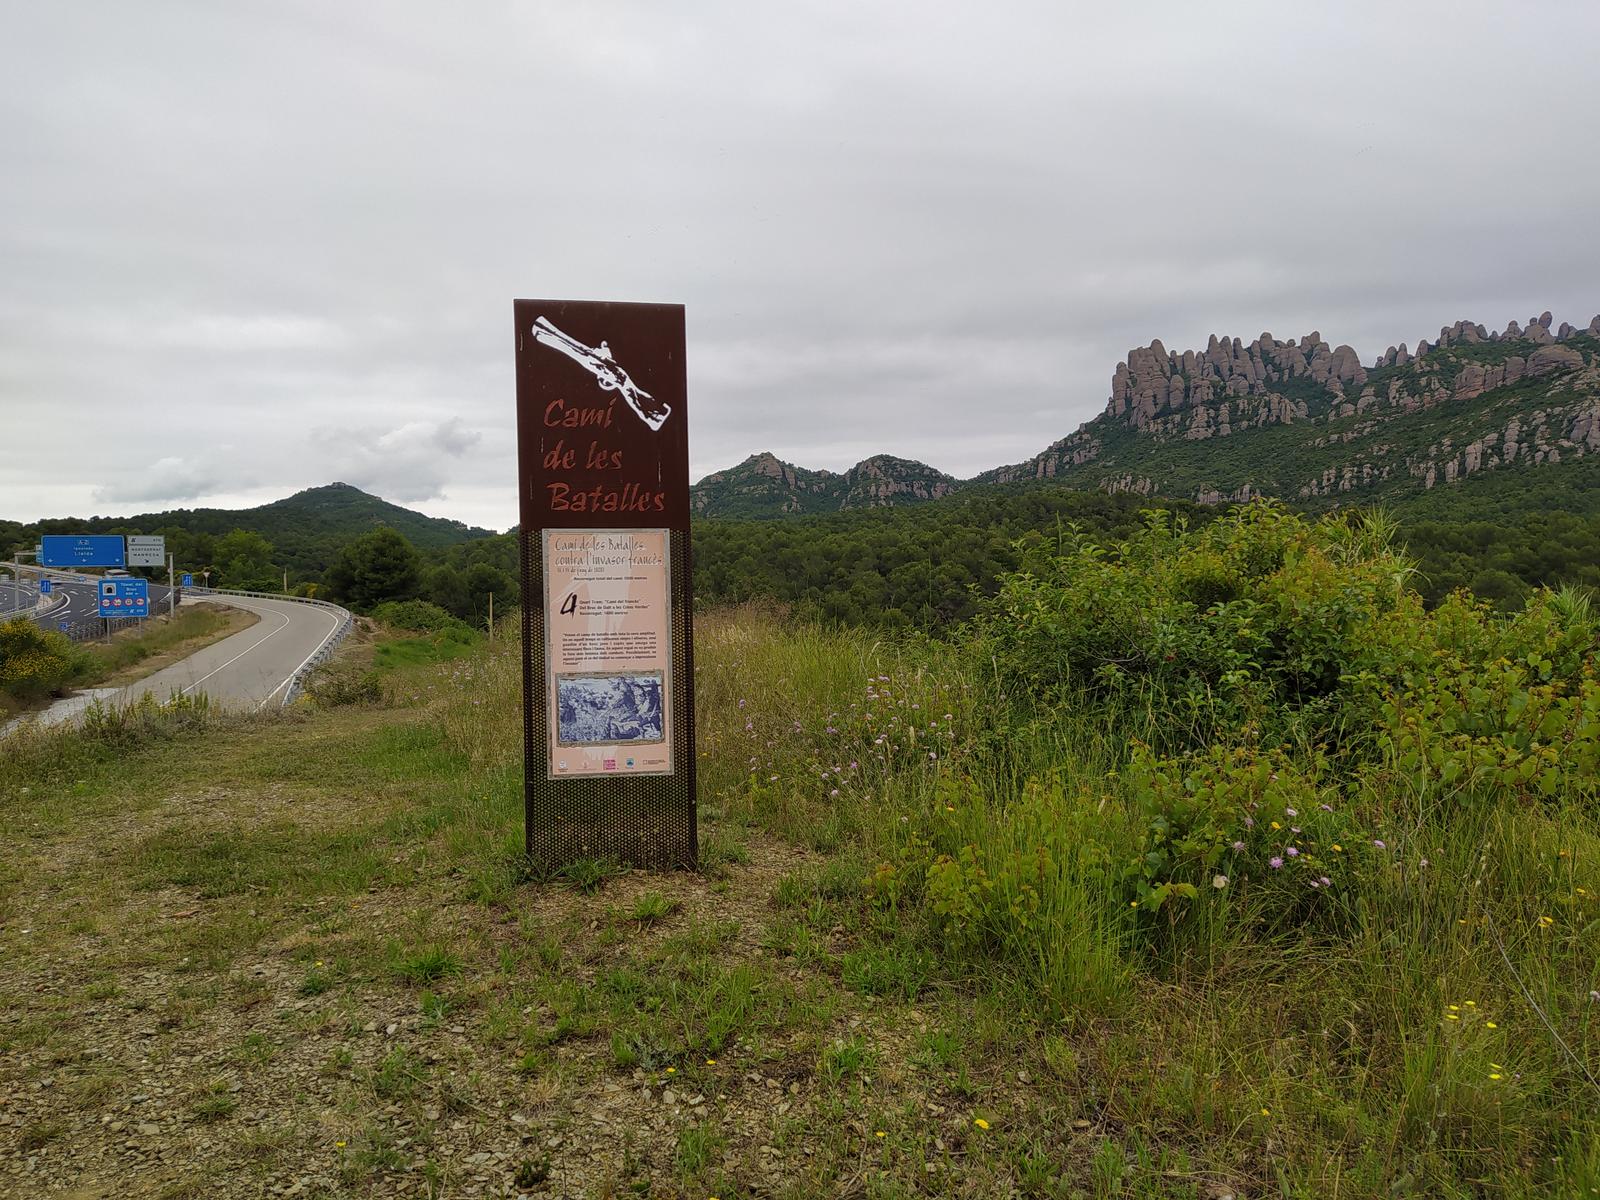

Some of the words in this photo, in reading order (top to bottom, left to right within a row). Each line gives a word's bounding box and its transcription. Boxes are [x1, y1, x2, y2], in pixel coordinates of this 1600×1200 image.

[543, 397, 617, 428] Camí
[543, 440, 576, 470] de
[586, 440, 623, 470] les
[546, 482, 665, 512] Batalles
[555, 538, 577, 551] Camí
[579, 536, 592, 551] de
[593, 536, 605, 551] les
[608, 536, 644, 551] Batalles
[555, 550, 583, 565] contra
[586, 550, 625, 565] l'invasor
[628, 551, 662, 568] francès
[560, 592, 578, 619] 4
